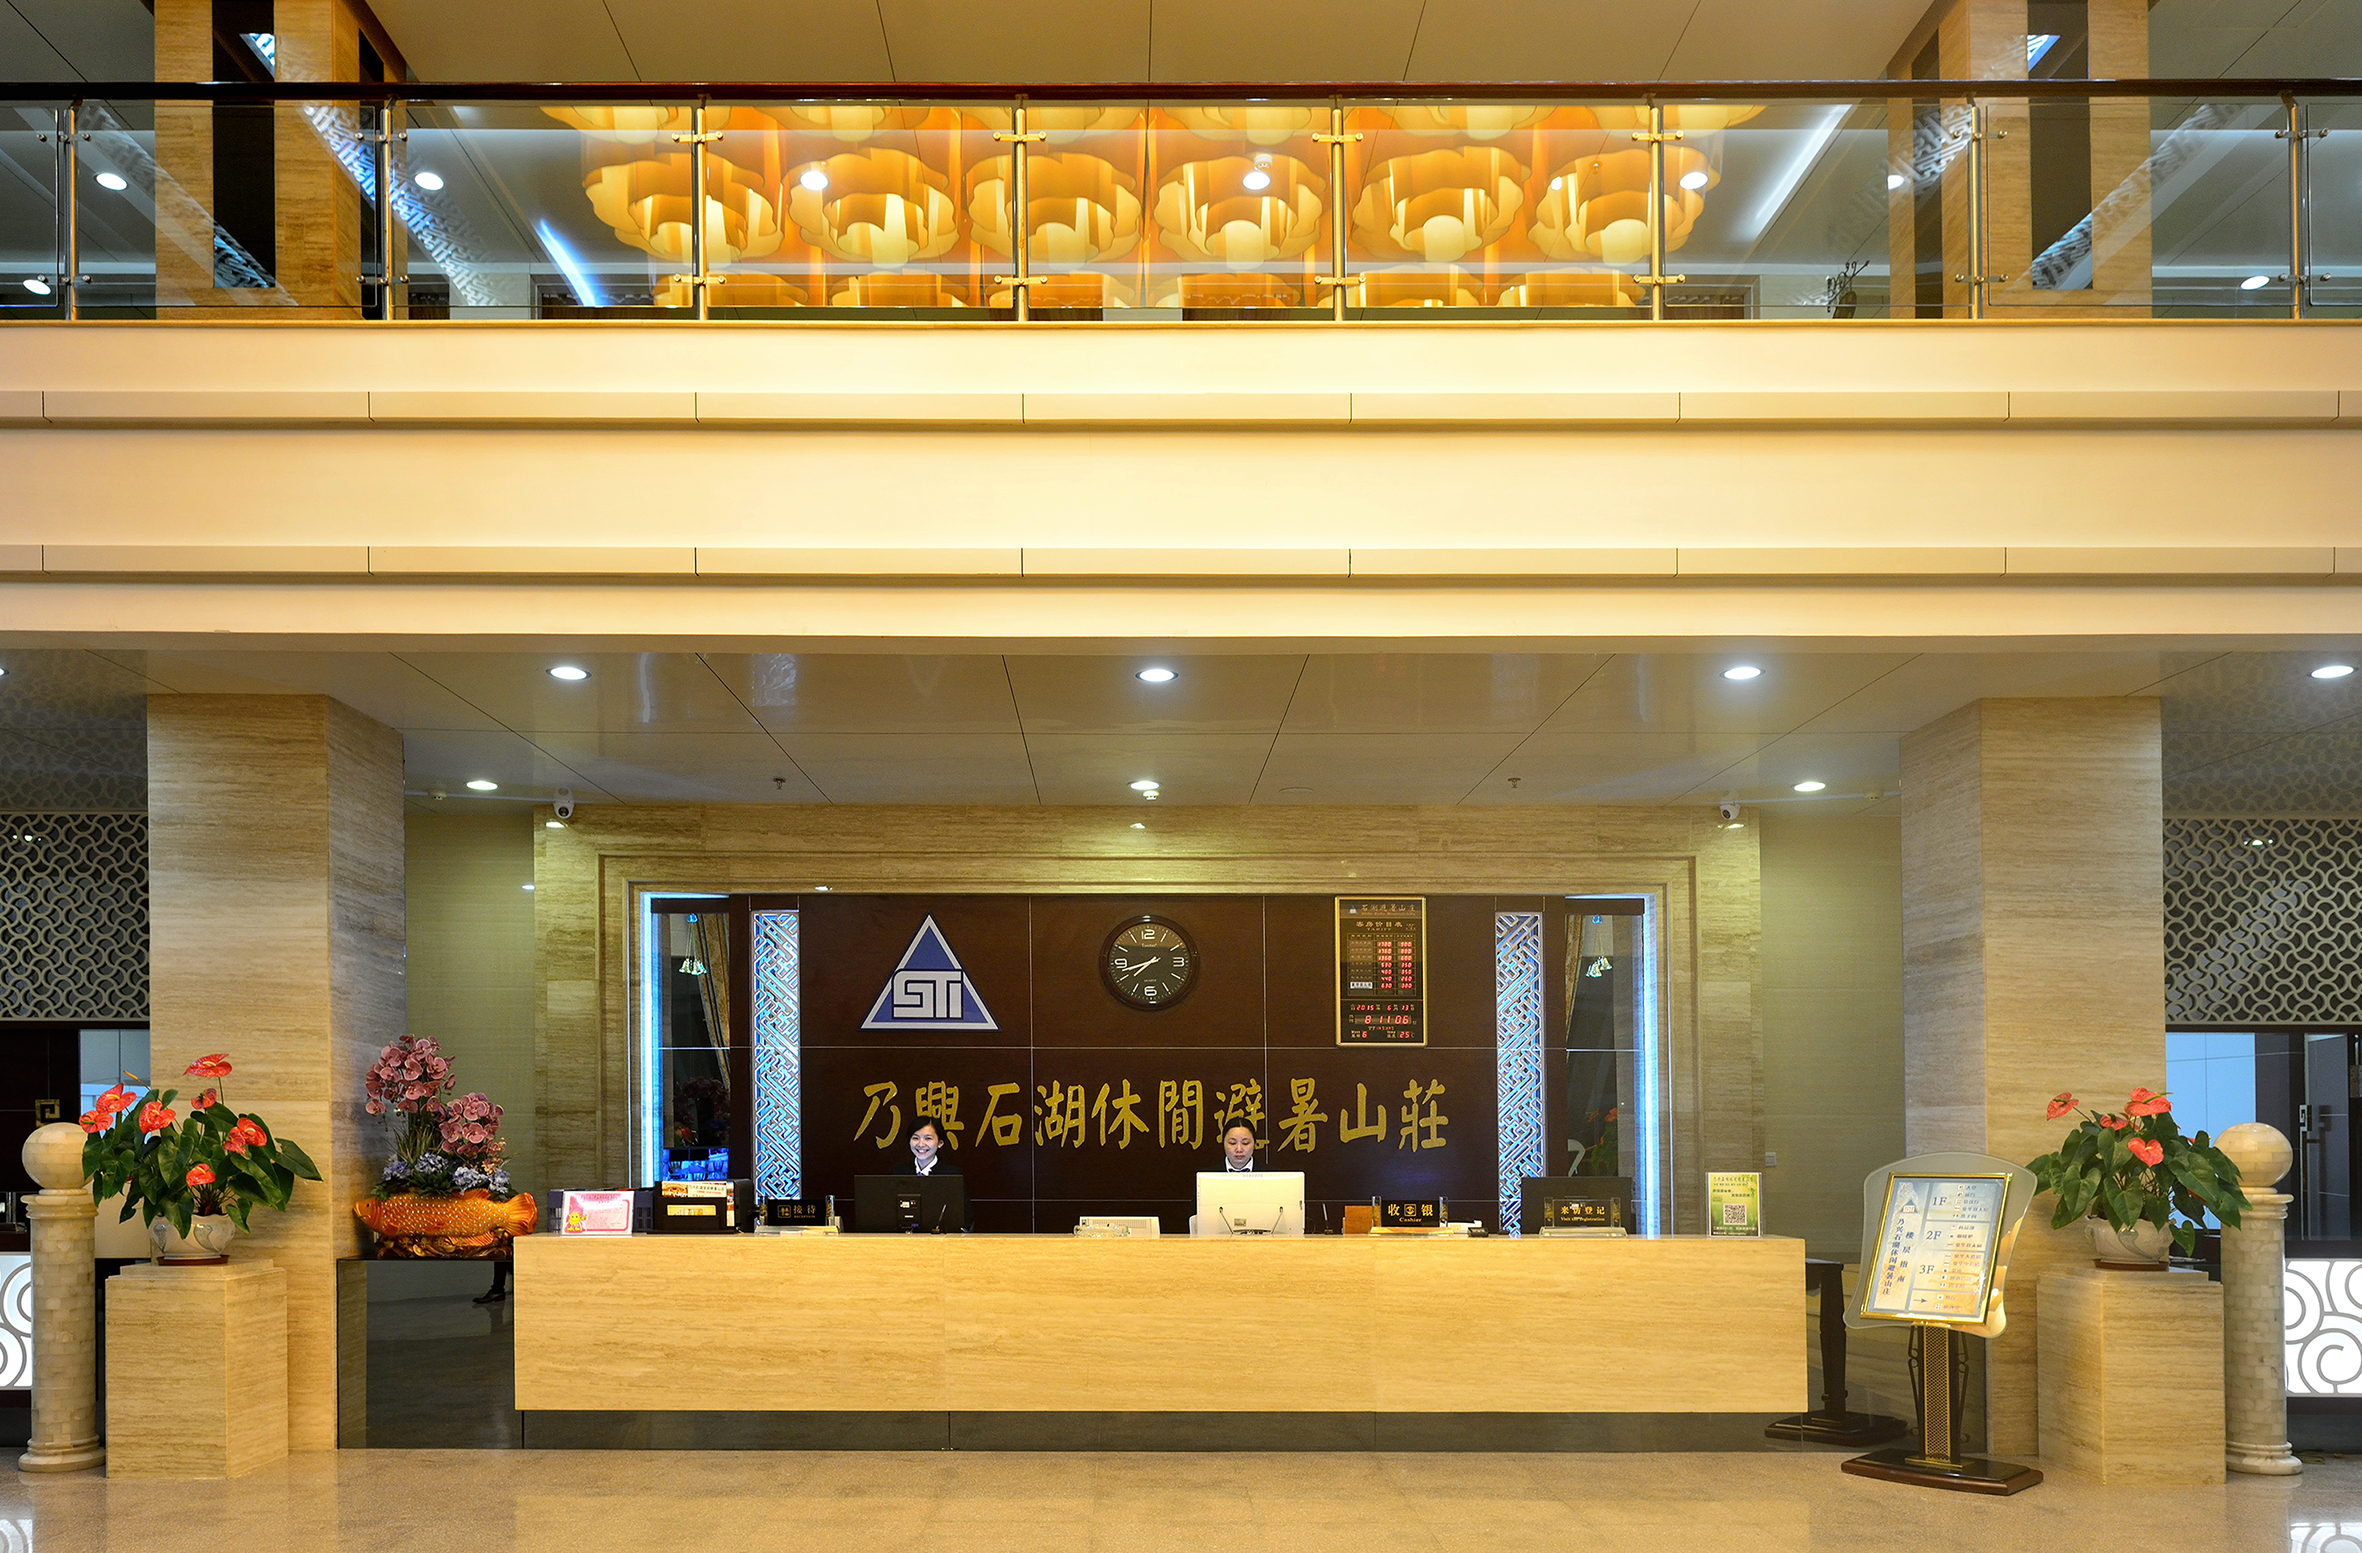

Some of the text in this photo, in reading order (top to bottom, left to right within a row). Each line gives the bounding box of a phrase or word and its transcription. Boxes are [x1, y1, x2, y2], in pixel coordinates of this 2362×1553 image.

[1141, 929, 1156, 940] 12
[1114, 958, 1128, 969] 9
[1173, 956, 1185, 967] 3
[1144, 985, 1158, 997] 6
[1364, 1014, 1372, 1025] 8
[1394, 1014, 1410, 1024] 06
[1932, 1196, 1948, 1206] 1F
[793, 1204, 816, 1214] 接待
[1926, 1230, 1942, 1240] 2F
[1896, 1231, 1914, 1283] 楼层指南
[1919, 1265, 1935, 1275] 3F
